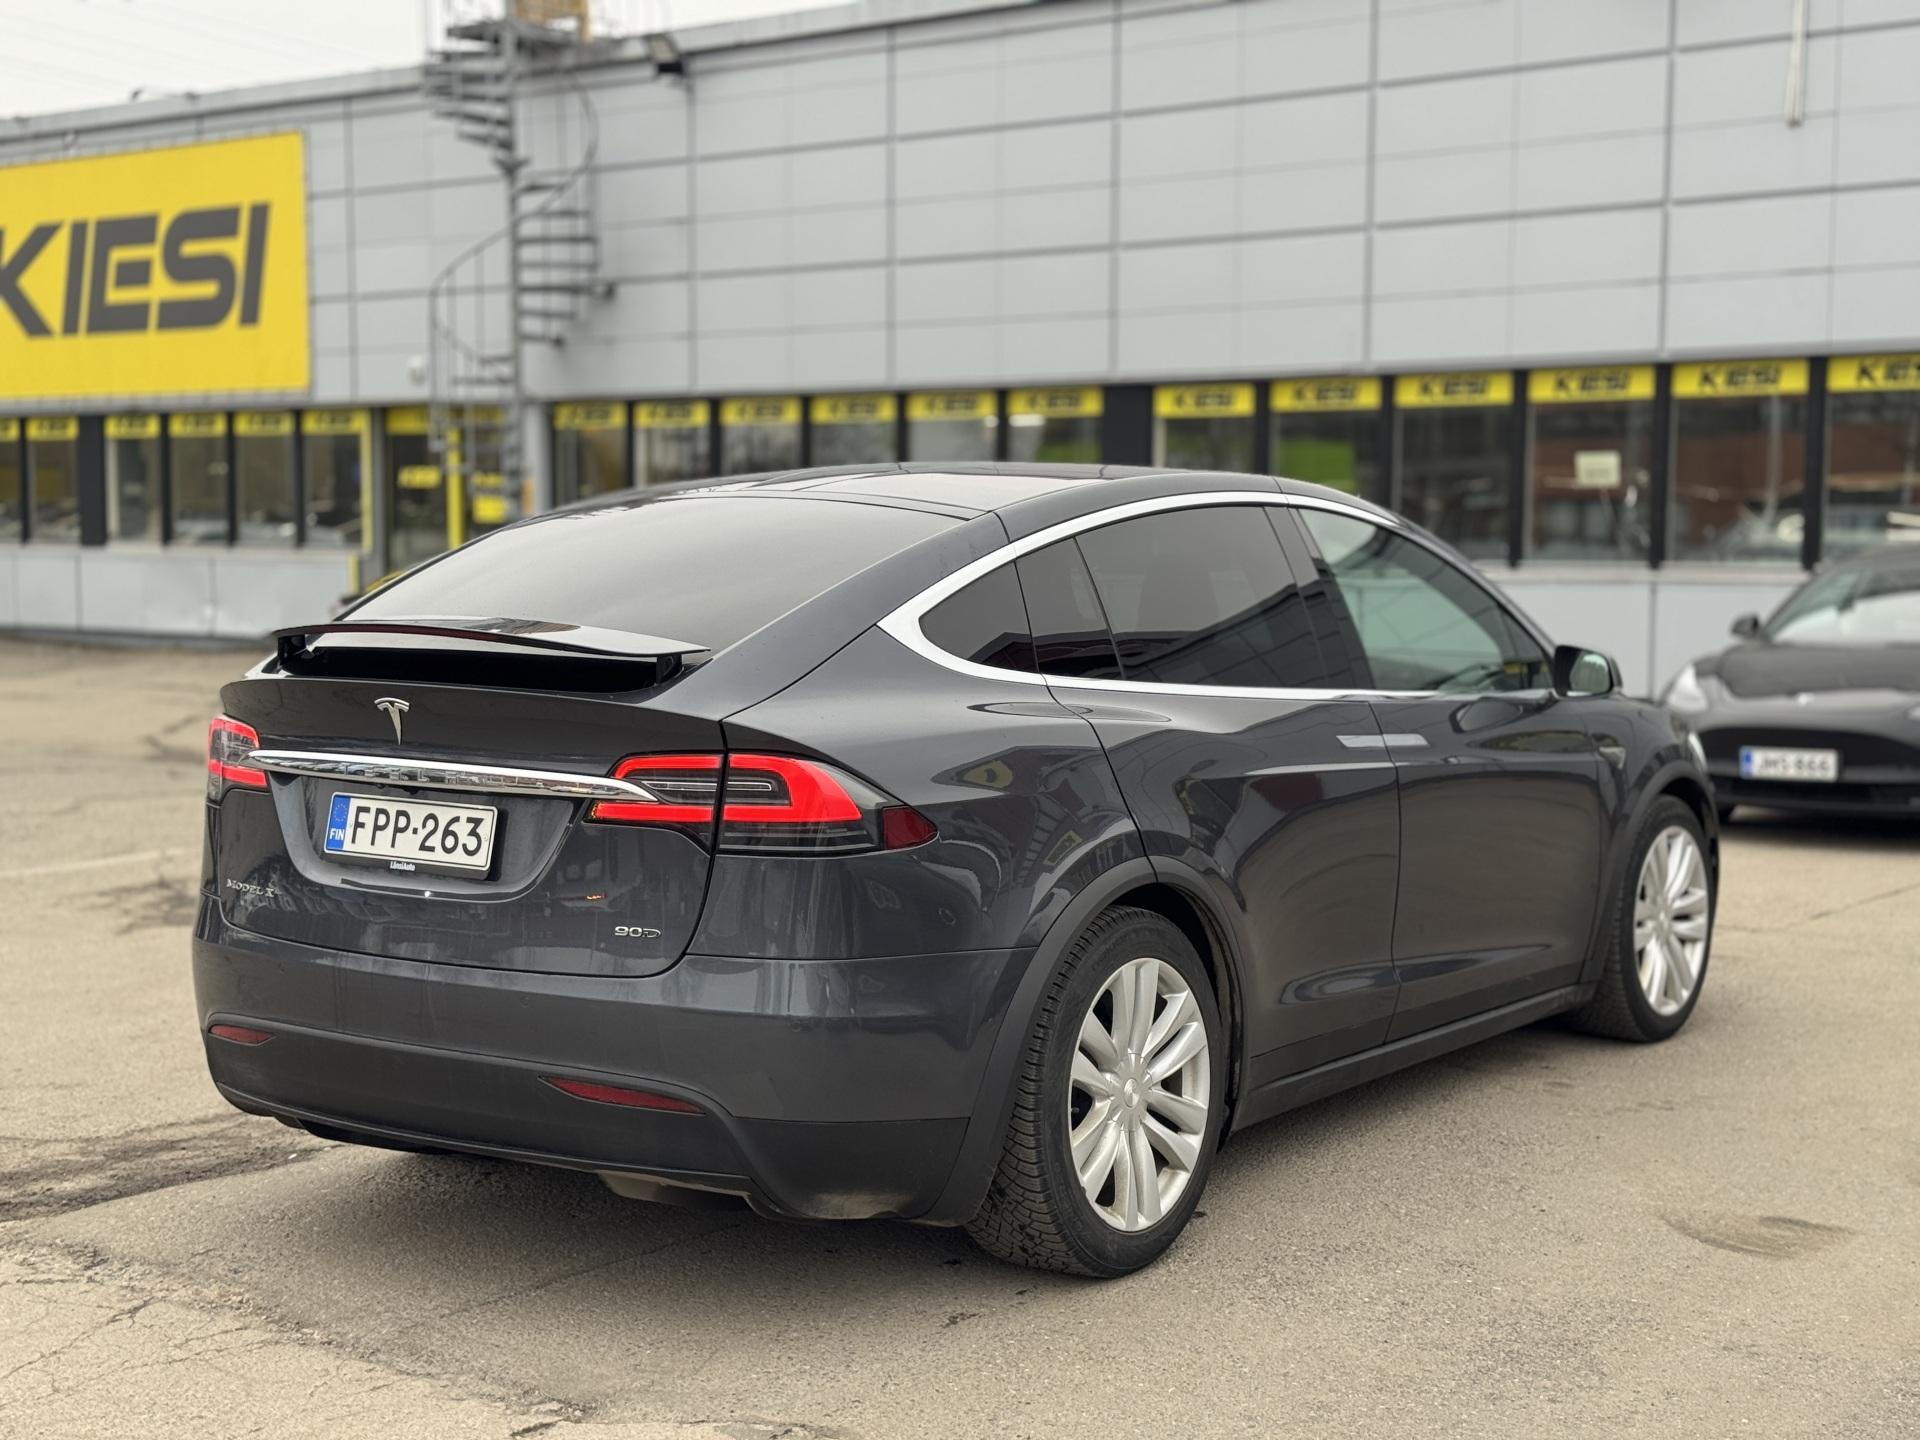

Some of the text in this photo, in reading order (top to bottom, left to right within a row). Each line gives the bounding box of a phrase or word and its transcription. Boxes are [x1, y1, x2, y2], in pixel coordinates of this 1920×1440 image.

[0, 202, 269, 338] KIESI
[329, 828, 344, 841] FIN
[615, 926, 661, 938] 90D
